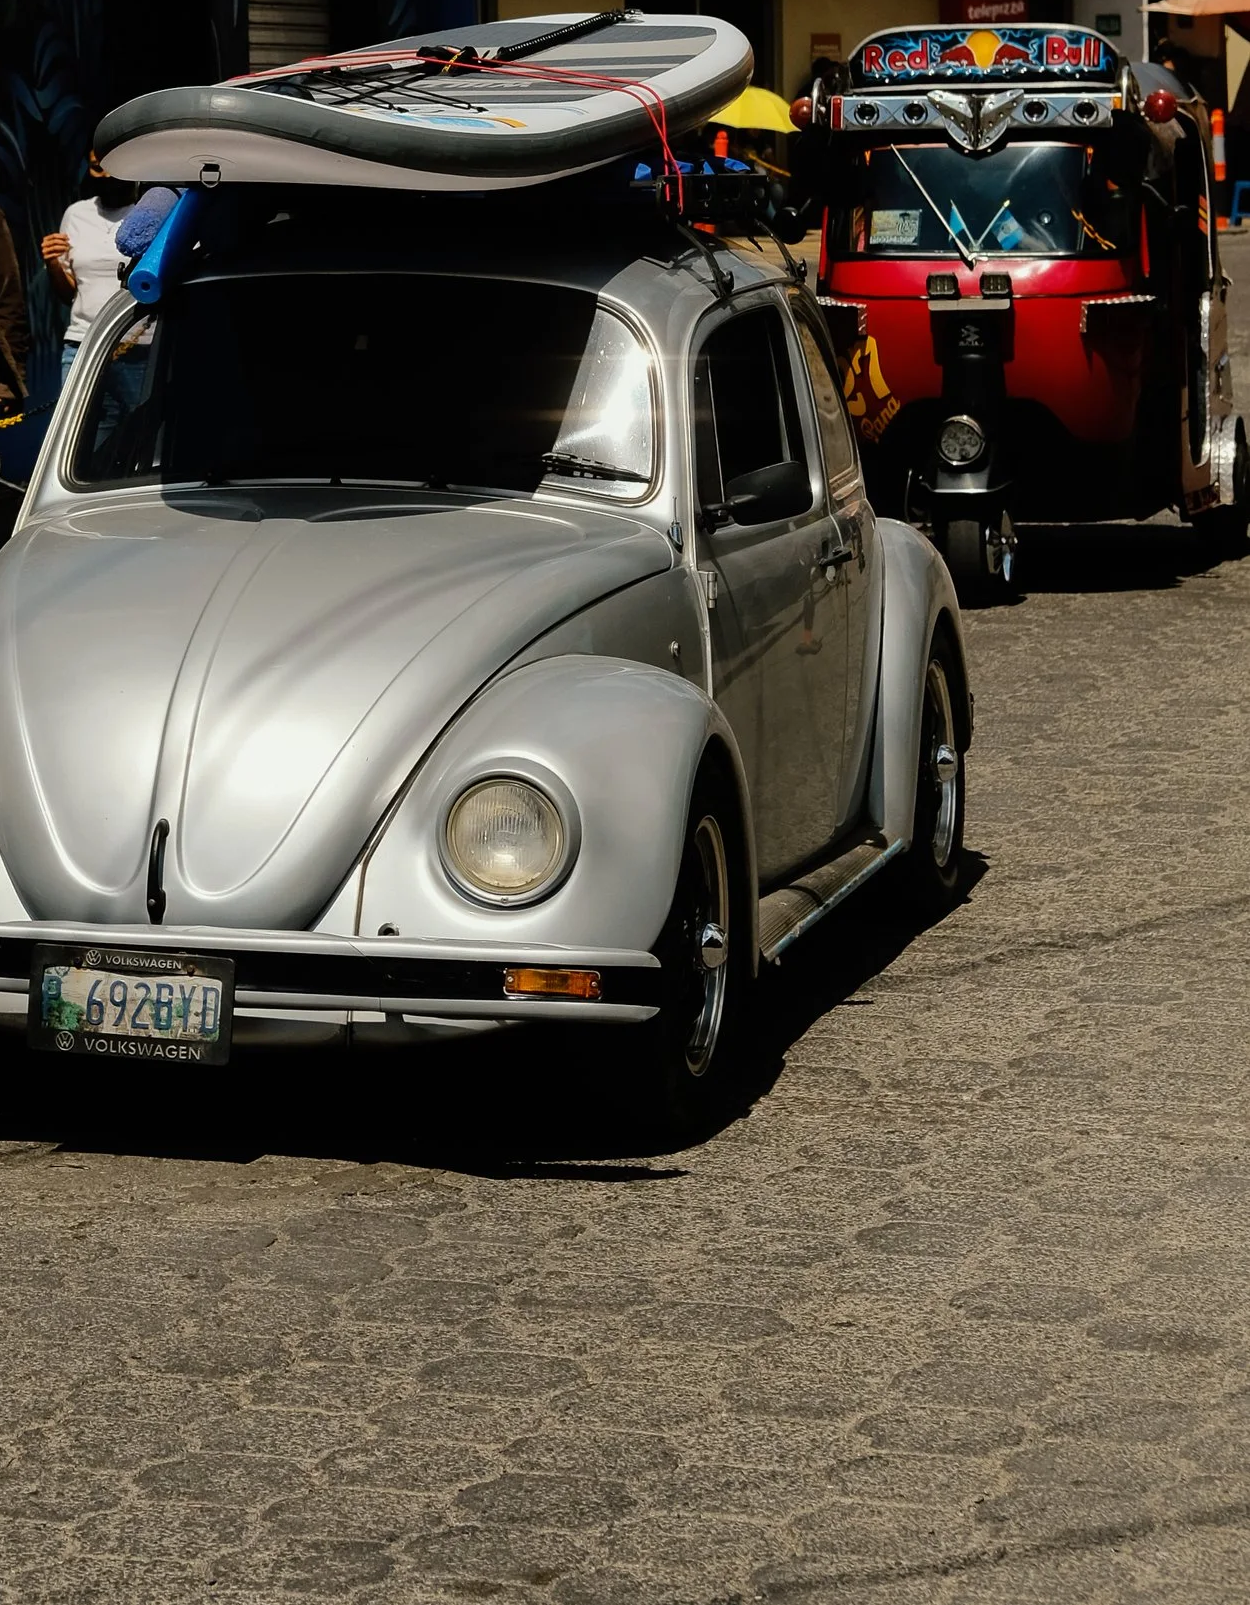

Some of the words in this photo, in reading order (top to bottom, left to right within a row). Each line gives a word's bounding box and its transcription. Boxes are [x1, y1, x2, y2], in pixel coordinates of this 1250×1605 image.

[864, 38, 930, 75] Red
[1044, 36, 1102, 69] Bull
[105, 955, 182, 971] VOLKSWAGEN
[86, 979, 221, 1035] 692BYD
[84, 1037, 202, 1061] VOLKSWAGEN
